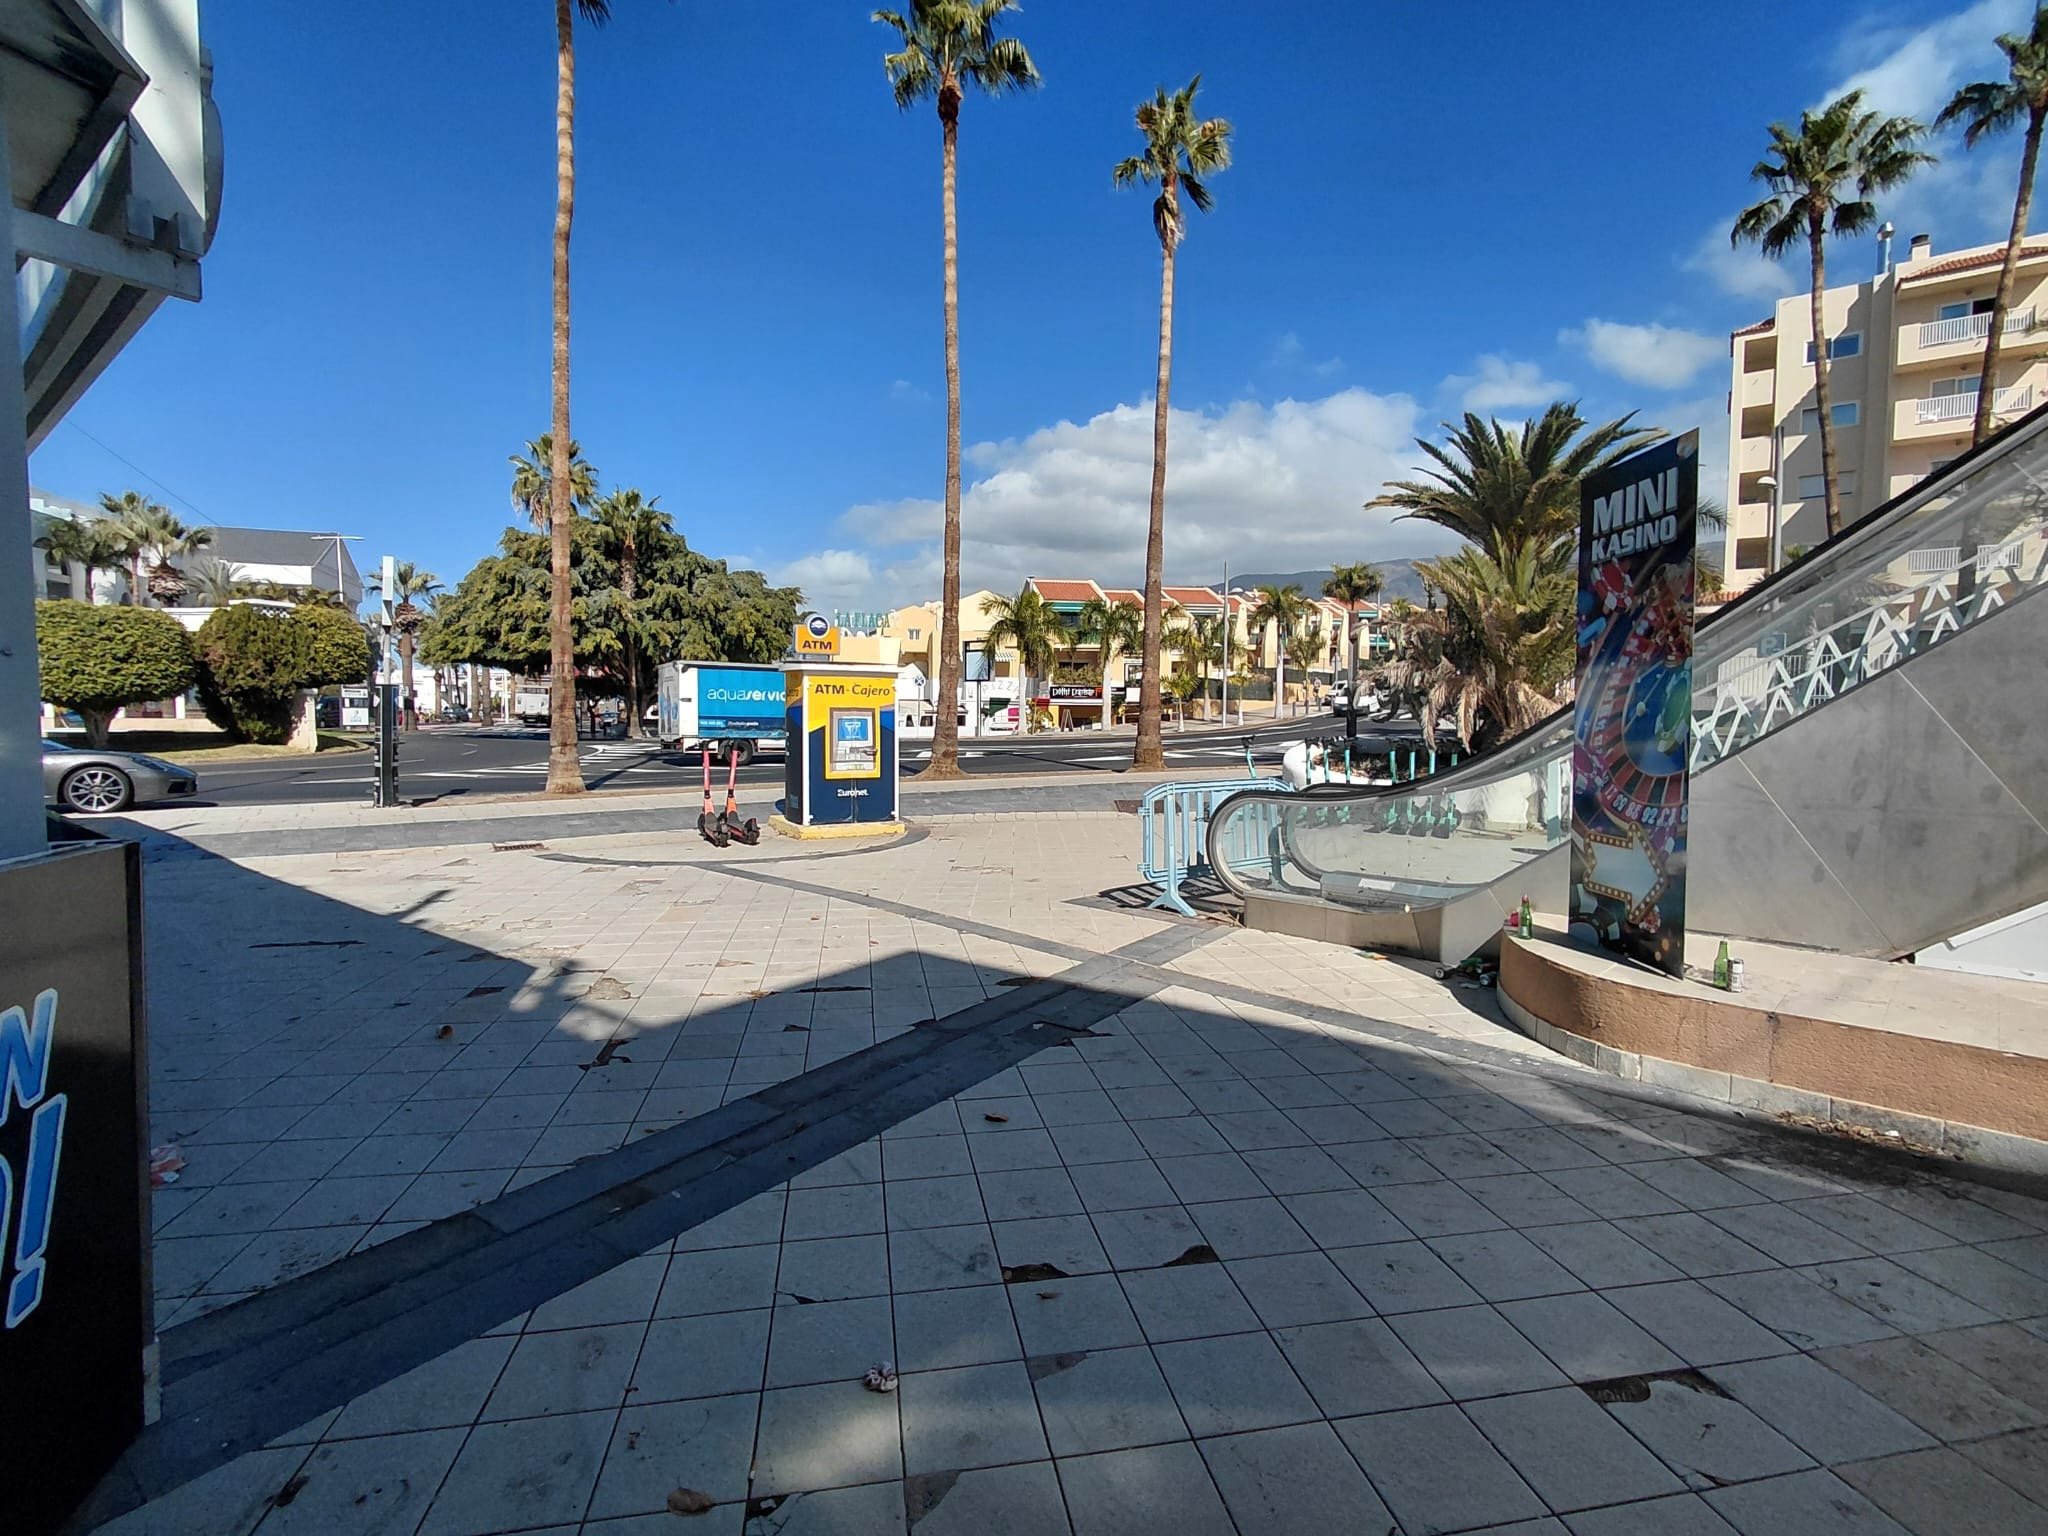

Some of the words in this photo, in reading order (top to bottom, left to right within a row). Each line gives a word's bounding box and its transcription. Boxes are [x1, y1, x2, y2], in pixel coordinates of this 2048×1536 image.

[1592, 467, 1680, 537] MINI
[1591, 514, 1678, 565] KASINO
[801, 640, 833, 651] ATM
[815, 684, 845, 694] ATM
[852, 684, 890, 698] Cajero
[837, 788, 869, 798] Euronet
